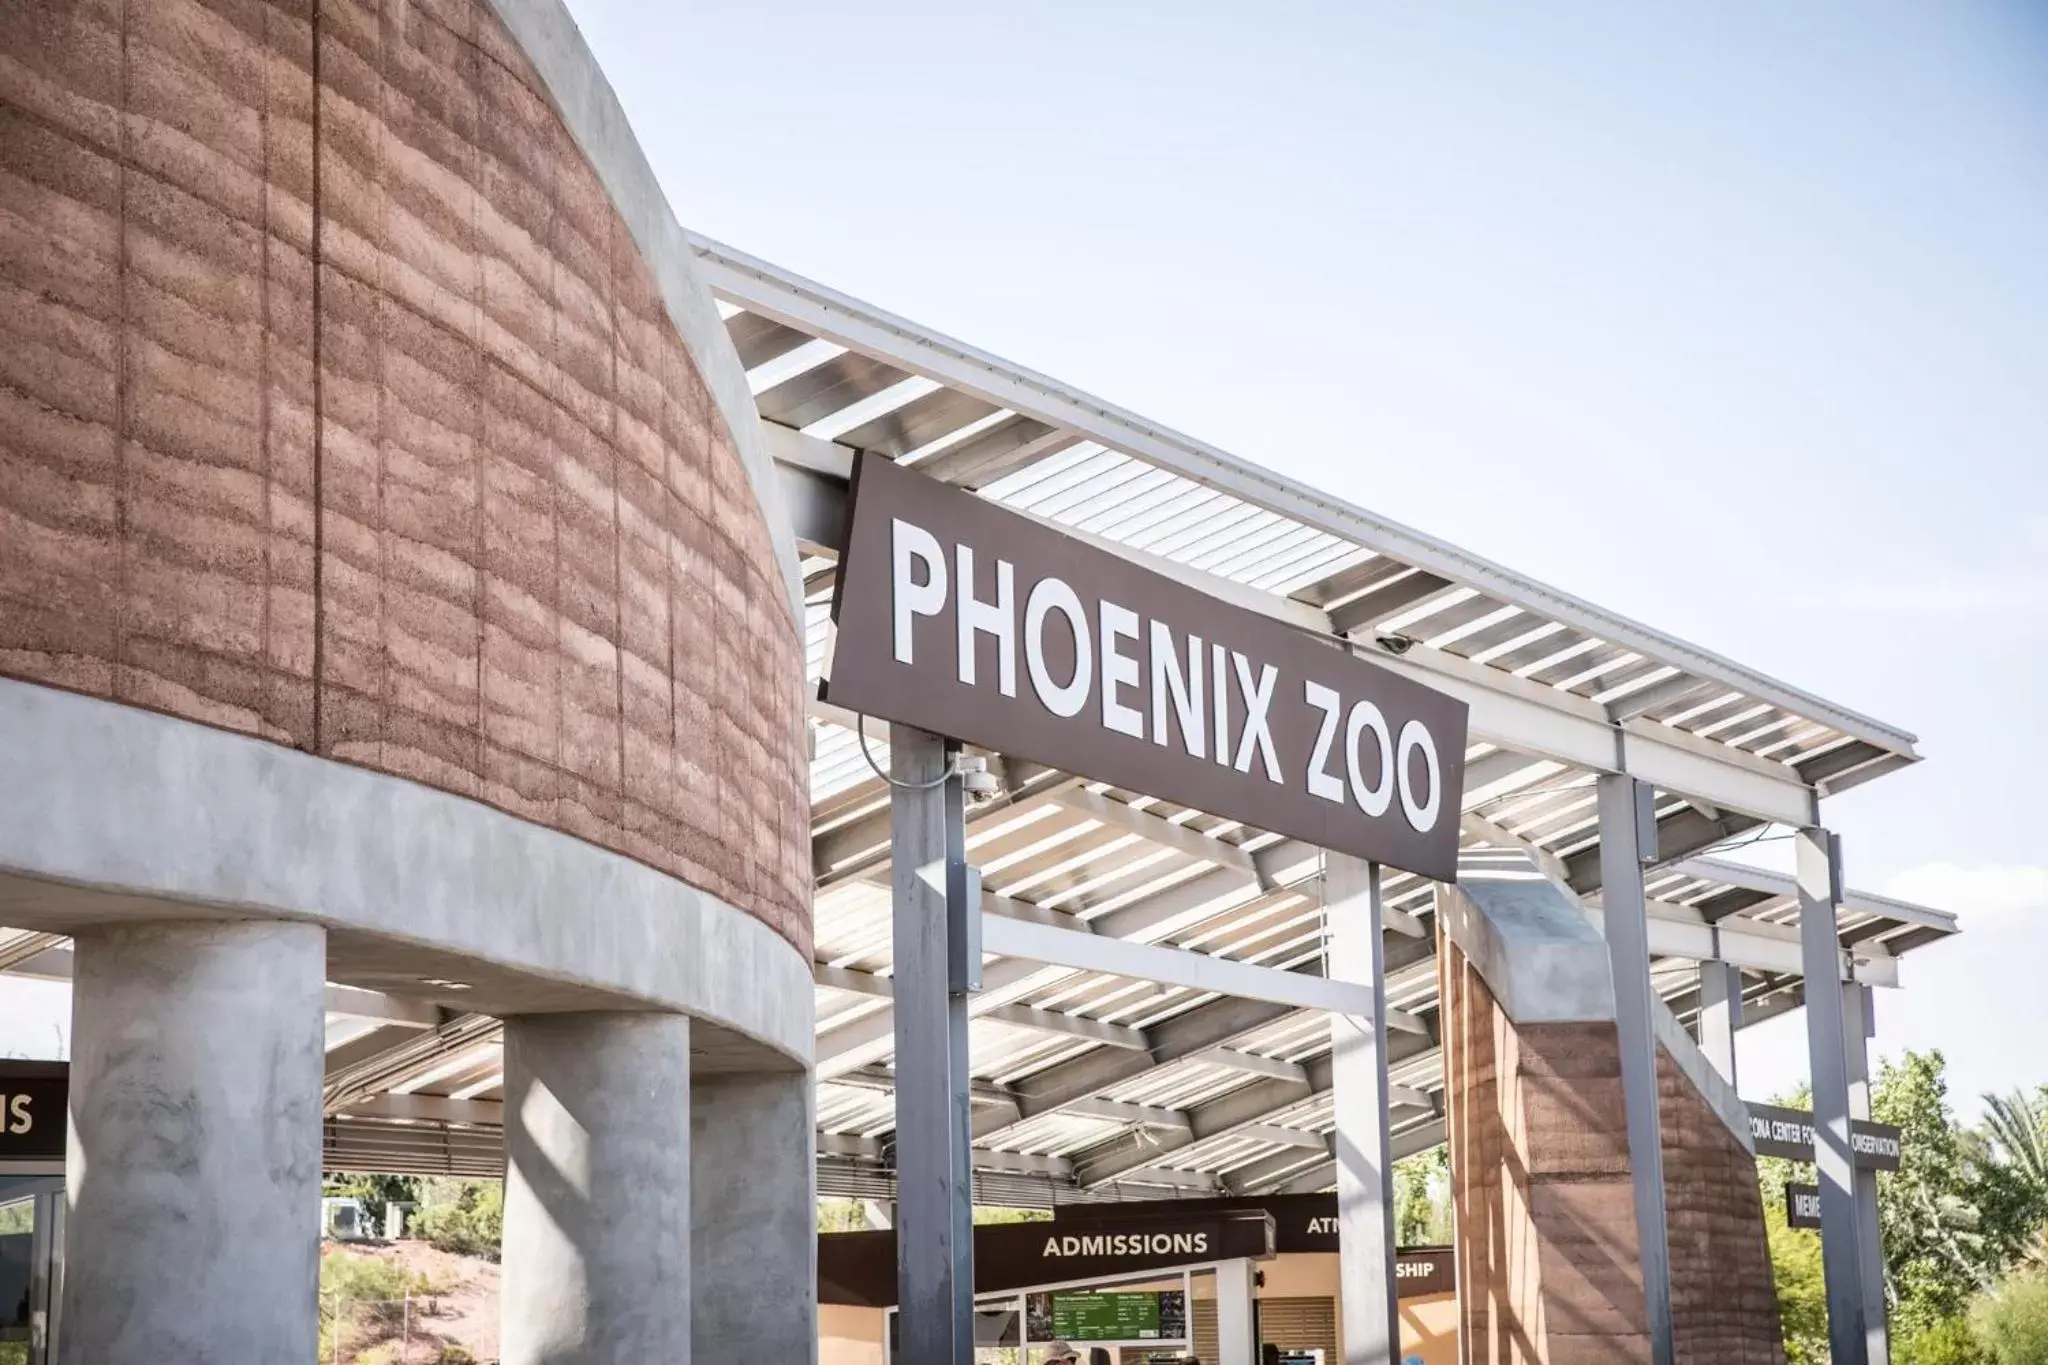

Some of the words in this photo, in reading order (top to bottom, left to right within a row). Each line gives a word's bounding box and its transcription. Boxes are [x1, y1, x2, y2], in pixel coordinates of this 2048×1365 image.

[890, 517, 1284, 785] PHOENIX
[1304, 680, 1441, 833] ZOO
[1772, 1120, 1802, 1144] CENTER
[1043, 1233, 1208, 1257] ADMISSIONS
[1396, 1262, 1435, 1278] SHIP
